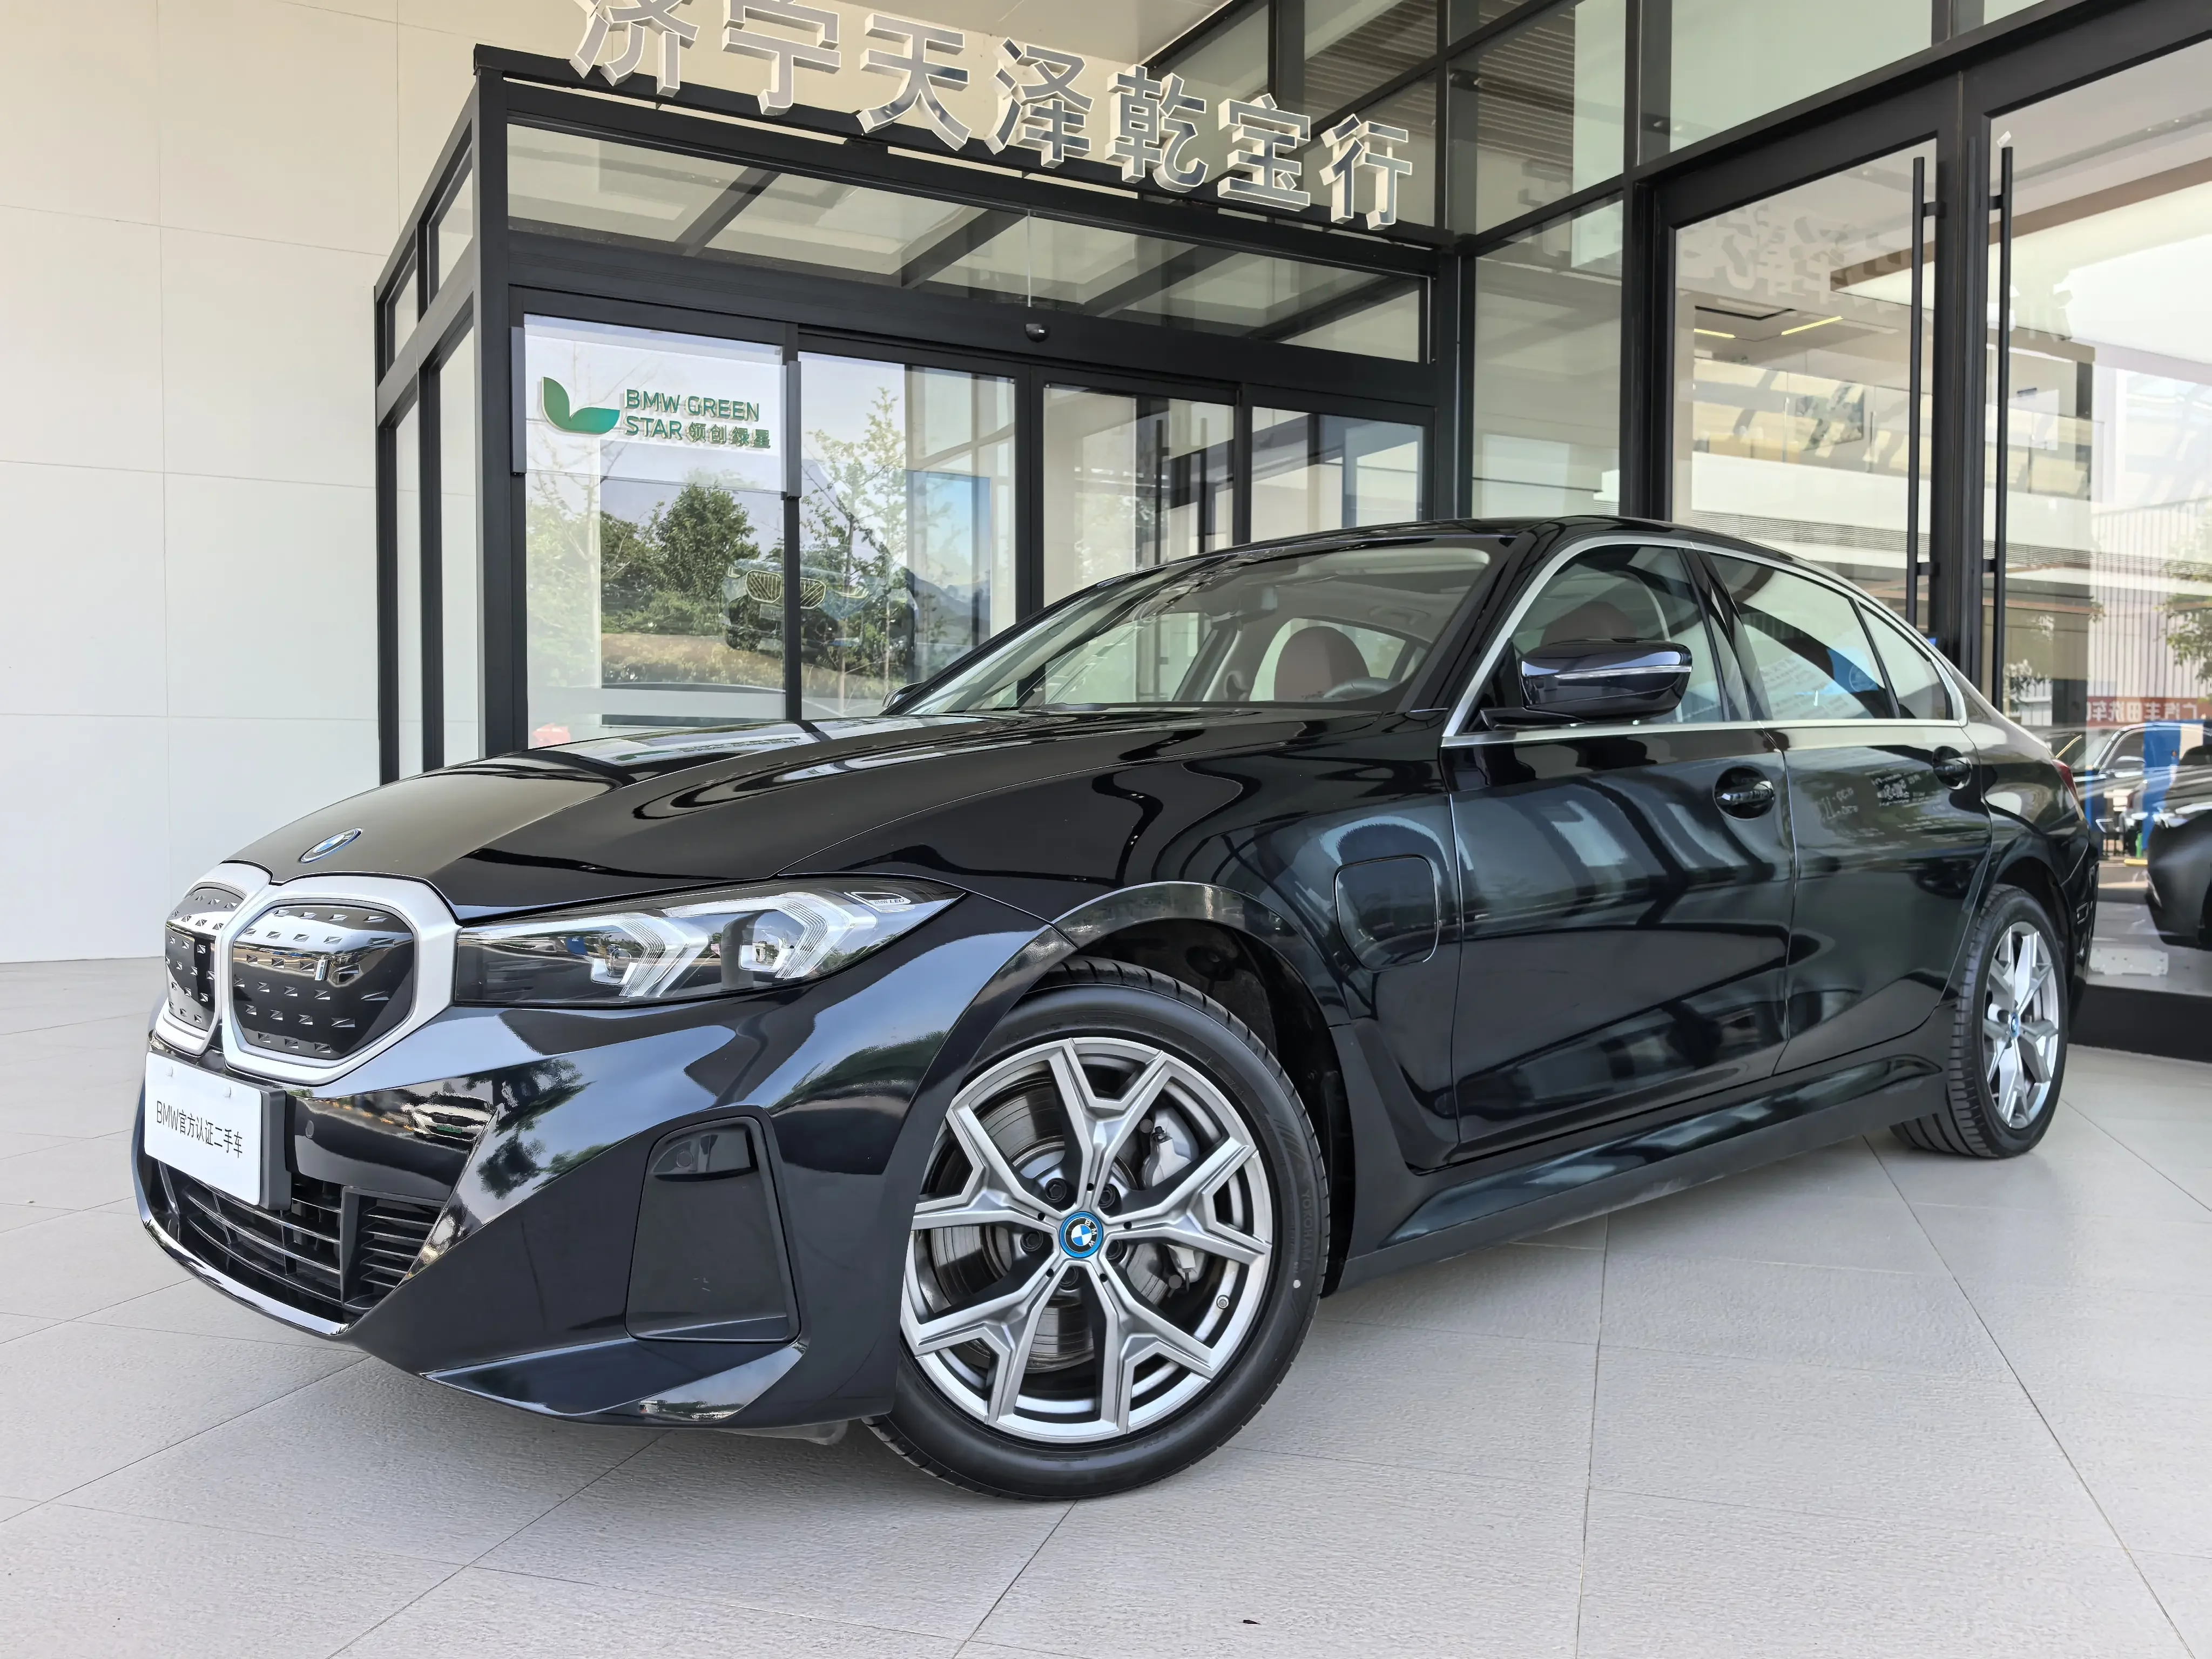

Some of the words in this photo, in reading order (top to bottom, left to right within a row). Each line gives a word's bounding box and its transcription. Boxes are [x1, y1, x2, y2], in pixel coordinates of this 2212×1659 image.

[624, 389, 680, 414] BMW
[685, 395, 759, 422] GREEN
[624, 415, 682, 441] STAR
[685, 422, 771, 449] 领创绿星
[157, 1101, 242, 1158] BMW官方认证二手车
[1084, 1219, 1097, 1247] BMW
[1301, 1189, 1312, 1271] YOKOHAMA
